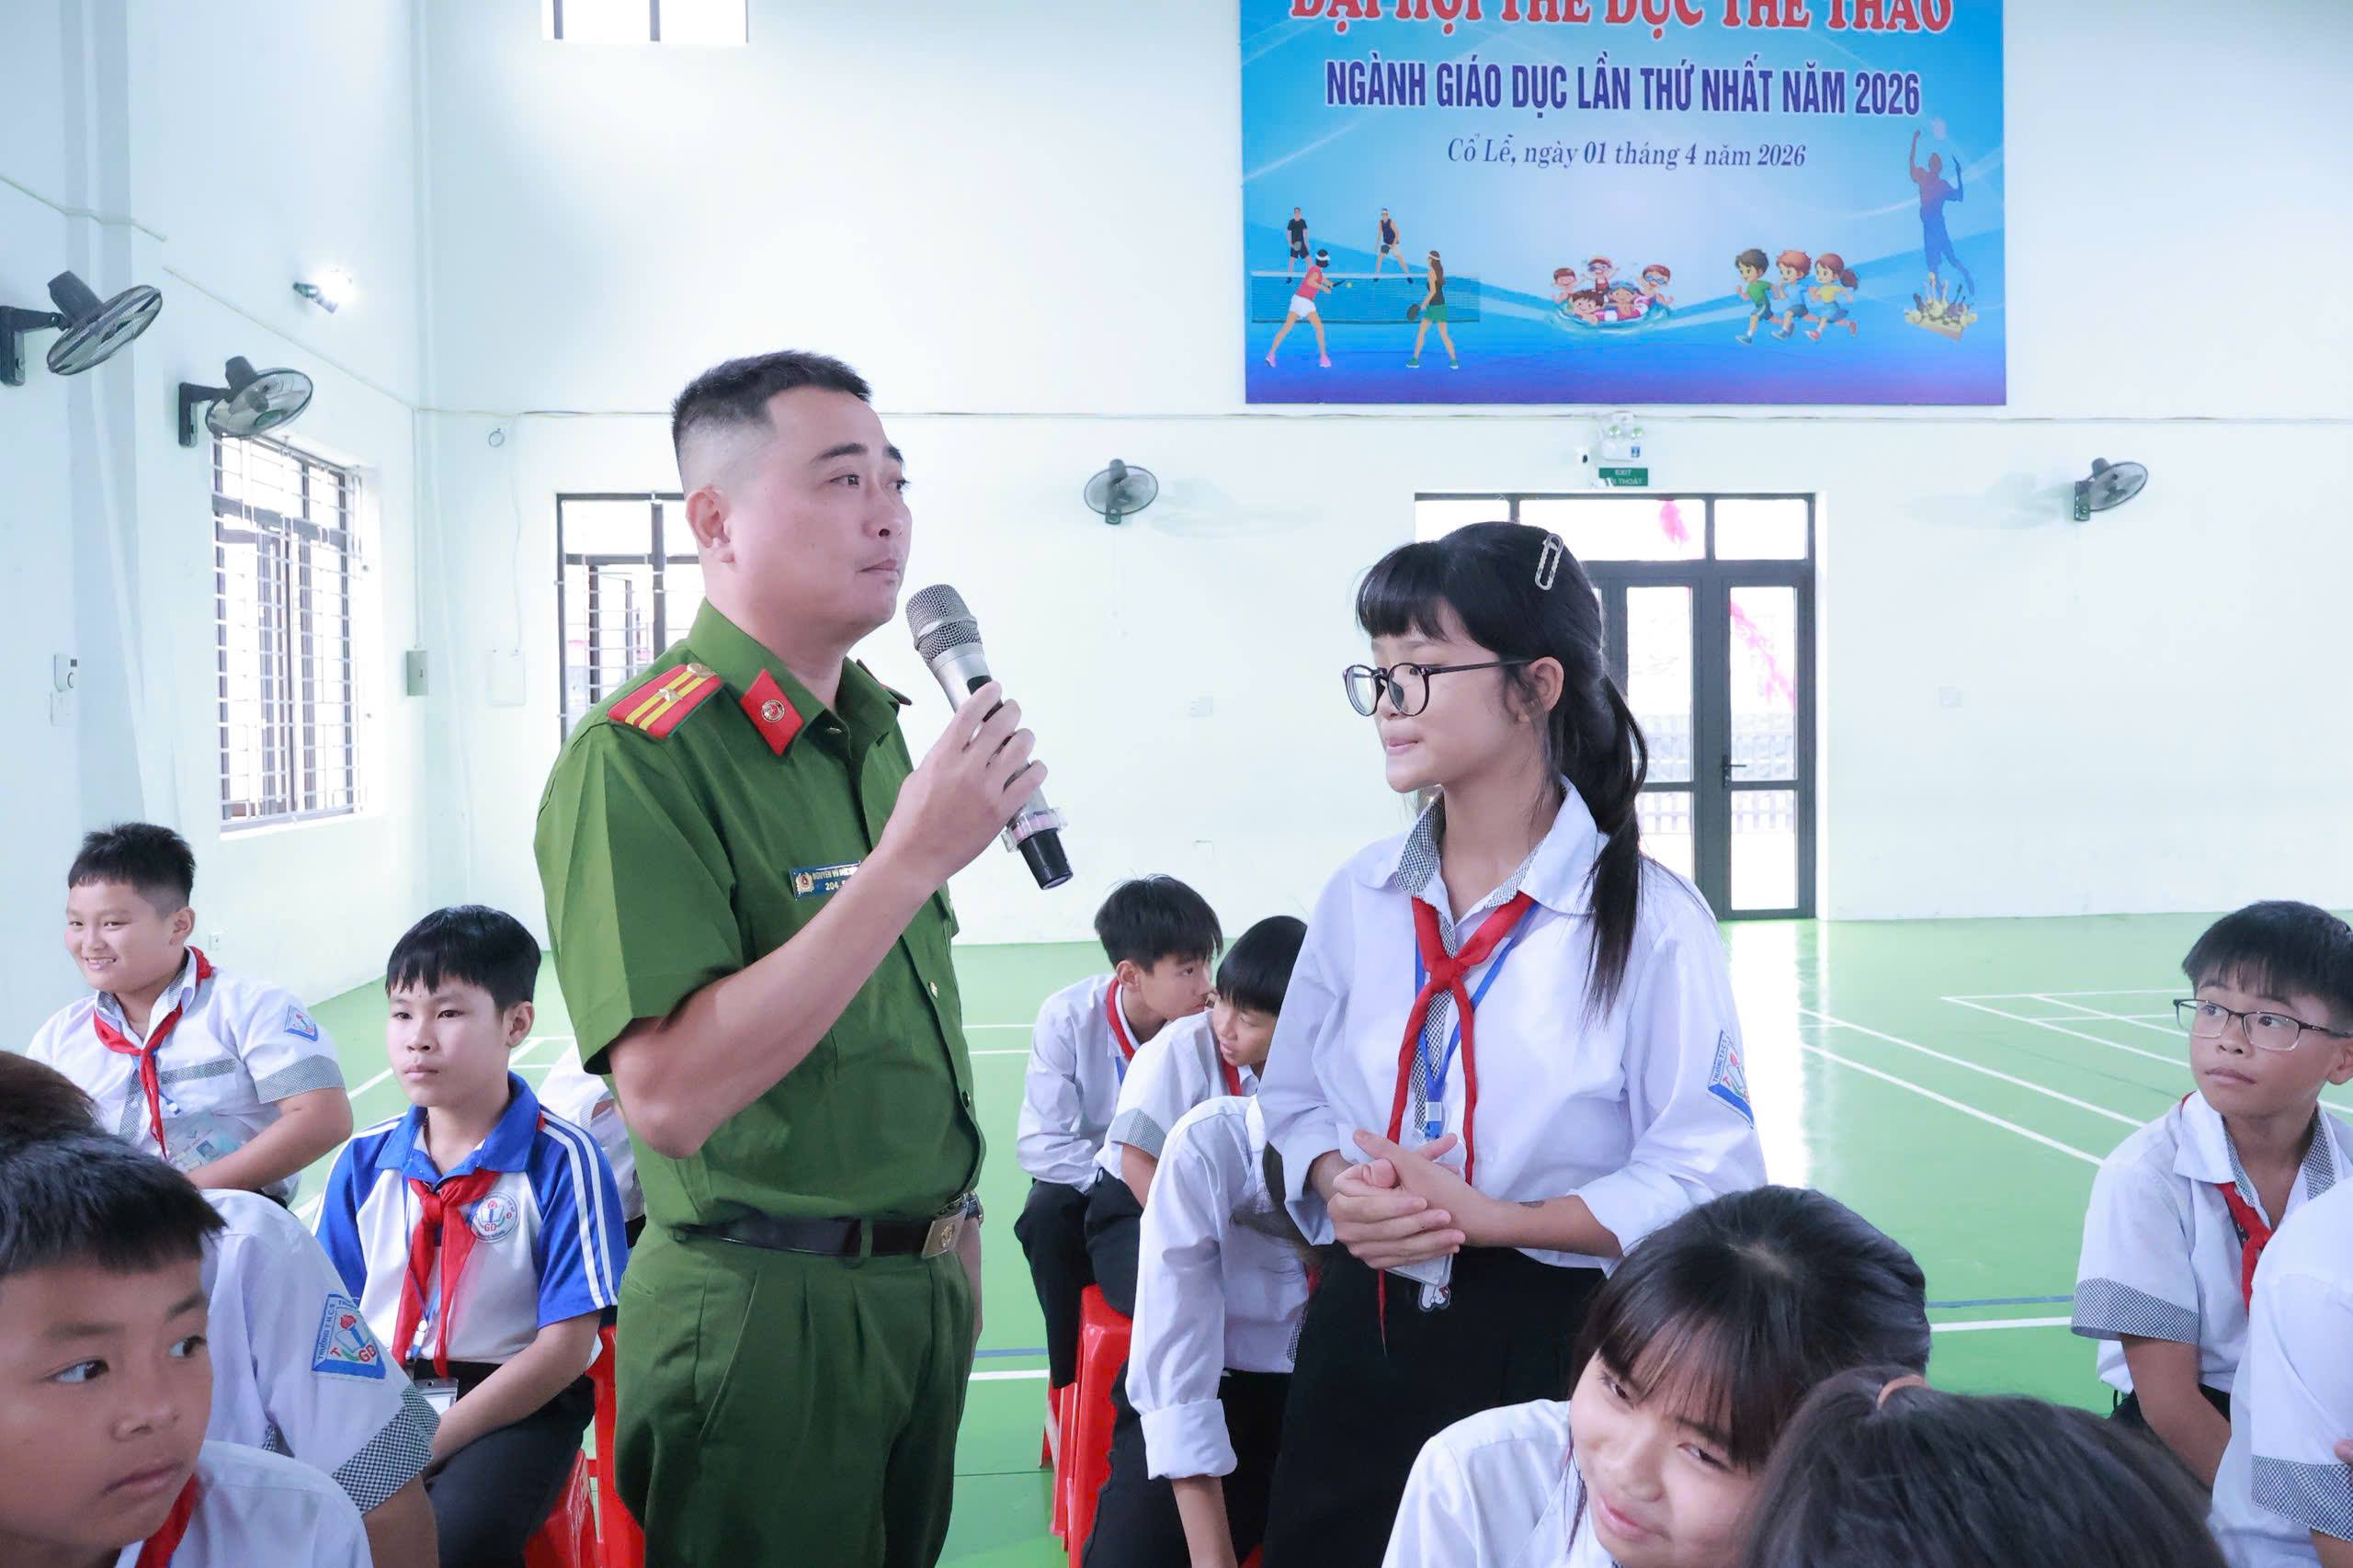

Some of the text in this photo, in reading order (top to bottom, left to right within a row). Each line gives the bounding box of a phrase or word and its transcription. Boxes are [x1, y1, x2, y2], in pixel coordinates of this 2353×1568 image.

[1326, 51, 1920, 119] NGÀNH GIÁO DỤC LẦN THỨ NHẤT NĂM 2026
[1448, 132, 1481, 163] Cổ
[1523, 141, 1578, 169] ngày
[1584, 141, 1607, 165] 01
[1615, 141, 1680, 172] tháng
[1685, 142, 1698, 165] 4
[1703, 143, 1751, 166] năm
[1756, 143, 1807, 167] 2026
